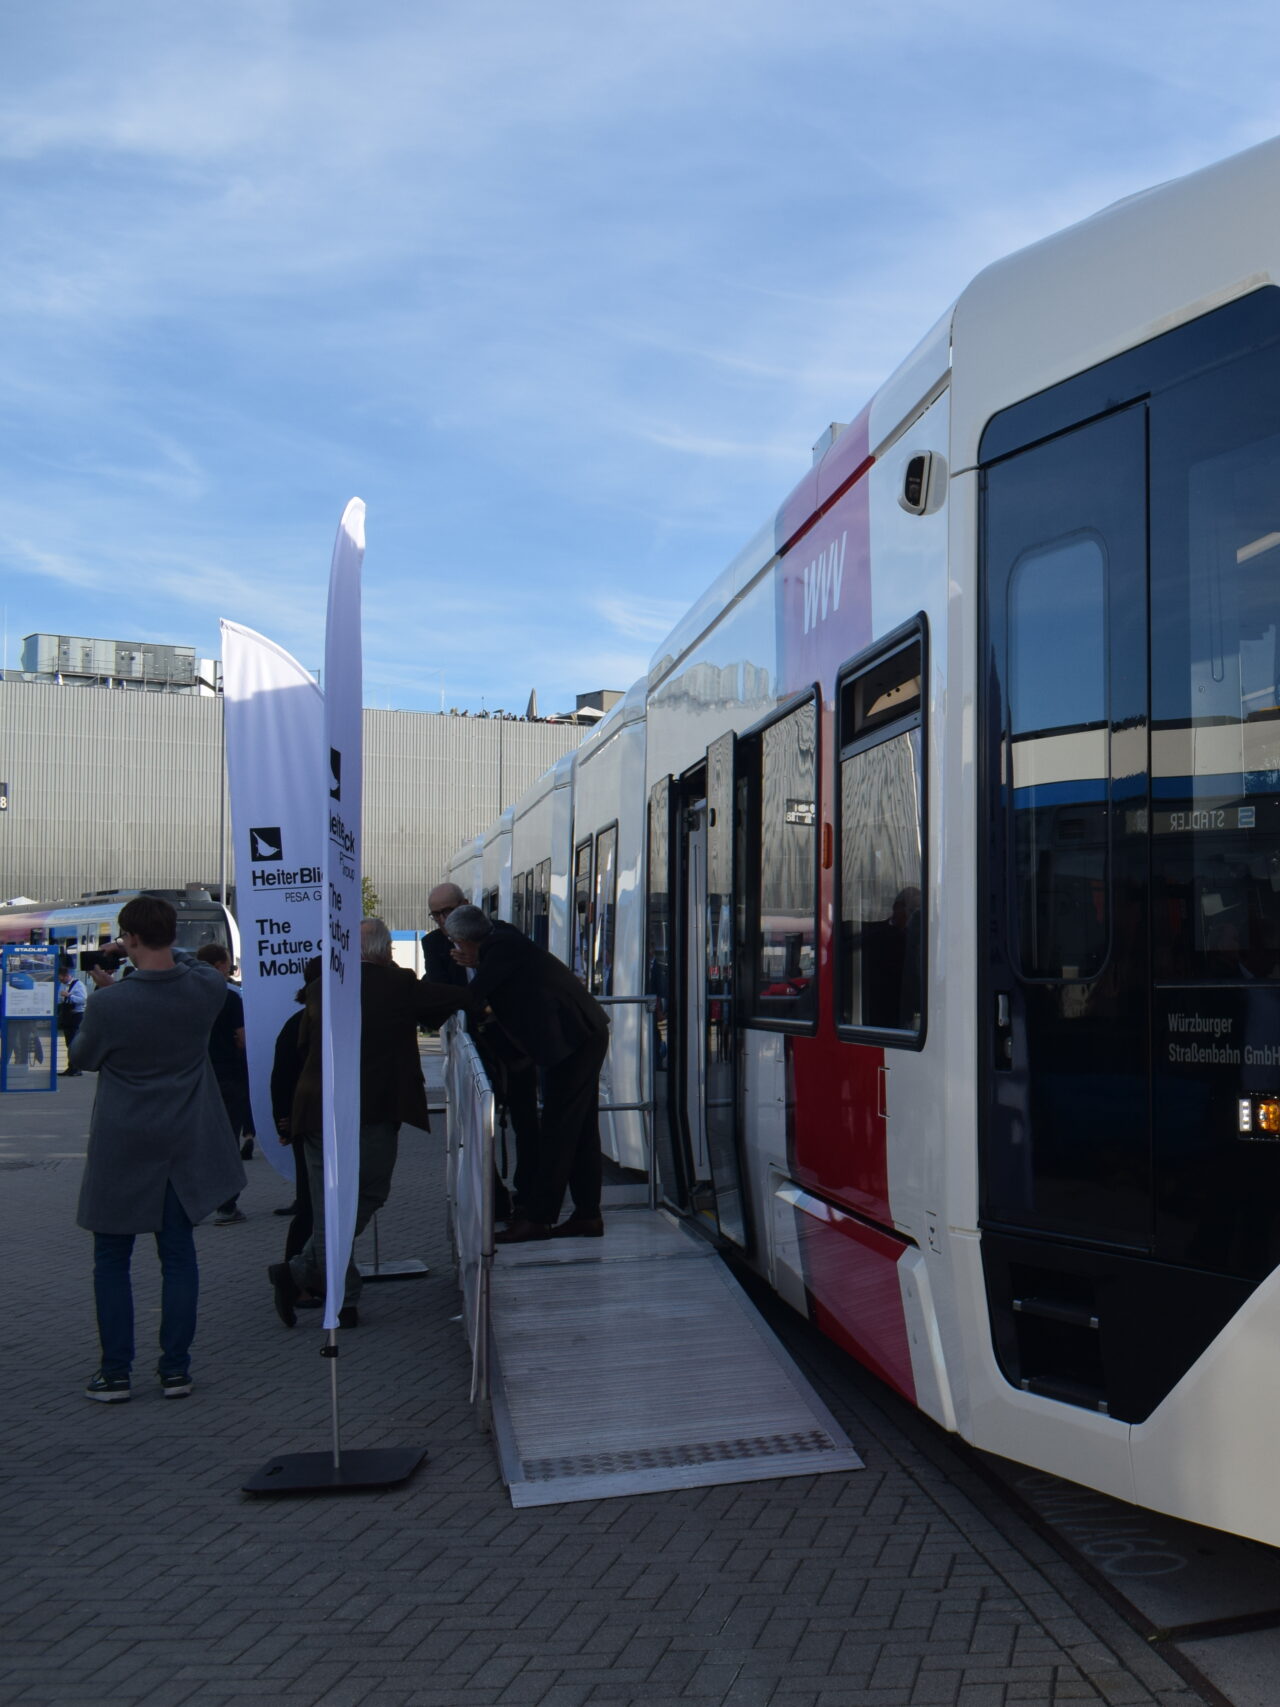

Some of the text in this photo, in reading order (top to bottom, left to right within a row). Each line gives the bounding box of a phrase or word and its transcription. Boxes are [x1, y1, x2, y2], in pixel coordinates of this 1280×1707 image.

[803, 530, 848, 635] WVV
[252, 866, 323, 887] HeiterBli
[285, 891, 310, 903] PESA
[255, 918, 291, 936] The
[258, 938, 313, 957] Future
[1168, 1012, 1233, 1038] Würzburger
[1168, 1042, 1241, 1065] Straßenbahn
